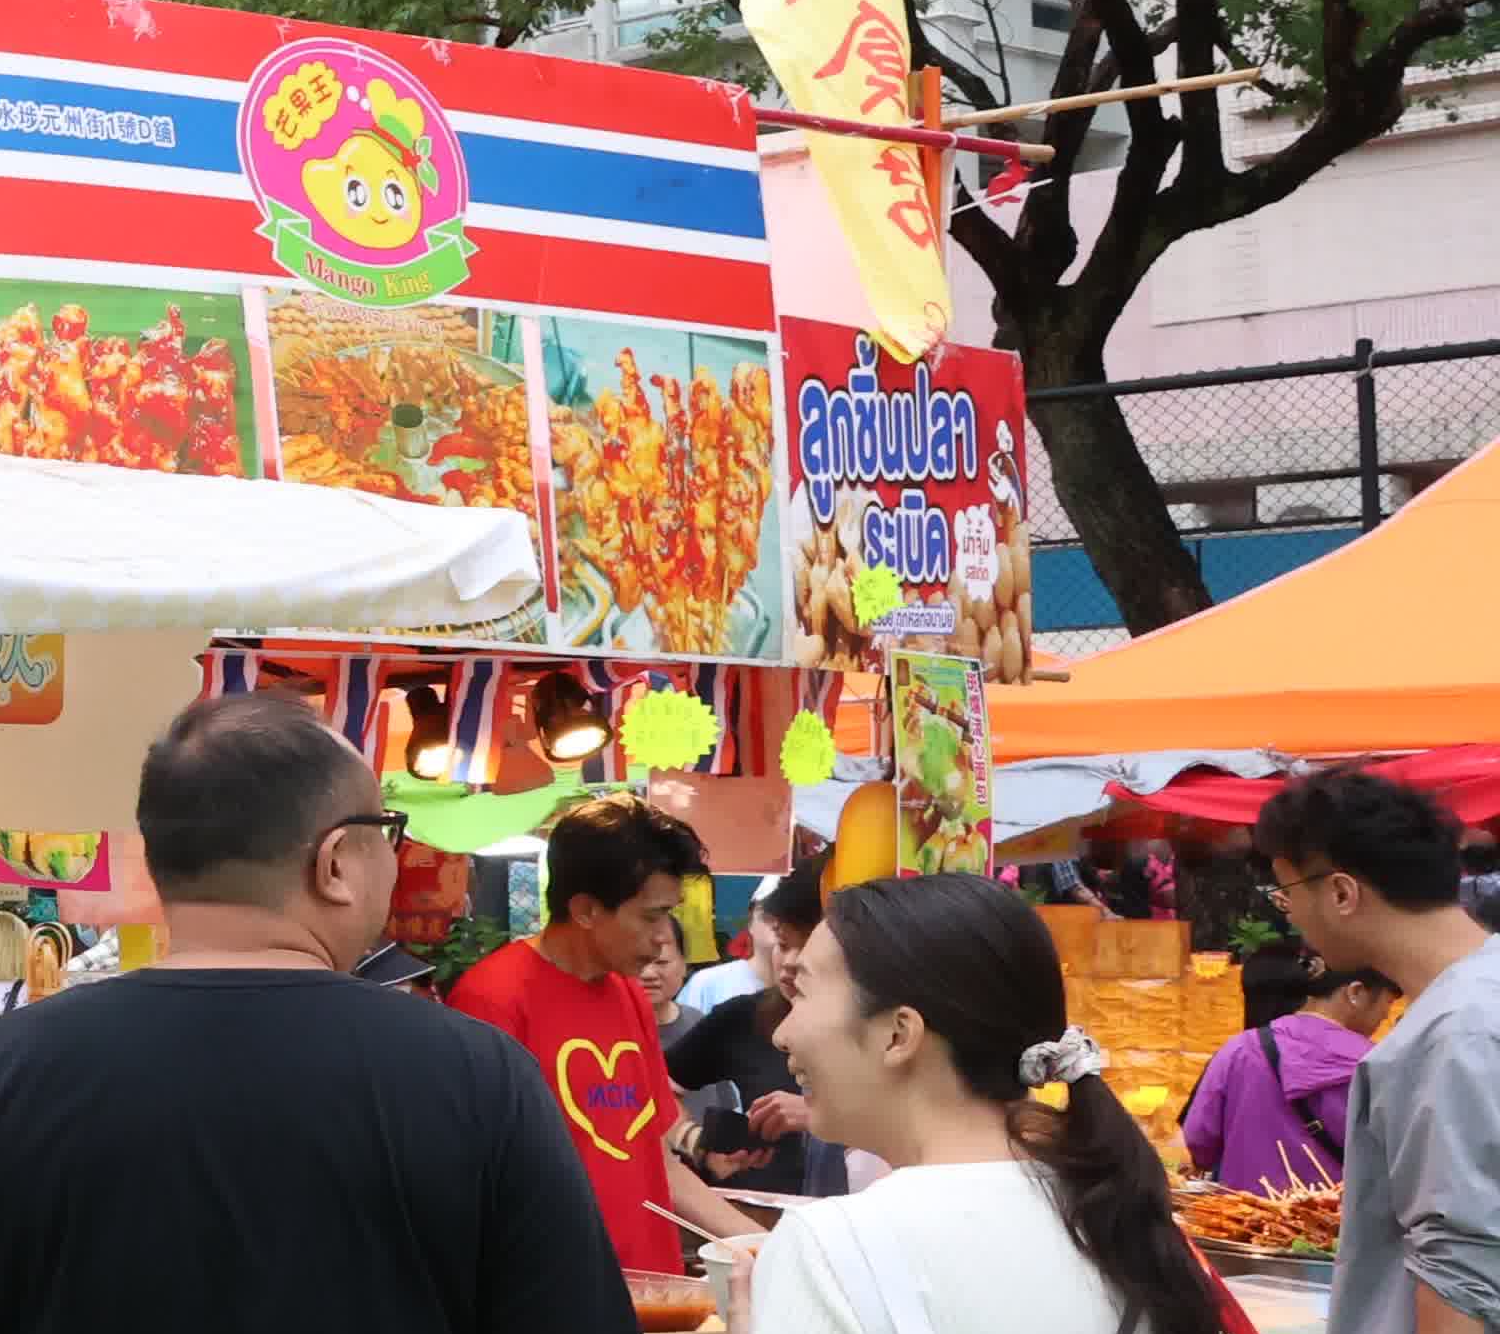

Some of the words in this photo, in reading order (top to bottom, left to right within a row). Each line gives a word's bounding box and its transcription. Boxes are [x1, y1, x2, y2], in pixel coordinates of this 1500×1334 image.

[275, 73, 334, 138] 芒果王
[304, 250, 377, 297] Mango
[380, 271, 433, 299] King
[798, 333, 977, 525] ลูกชิ้นปลา
